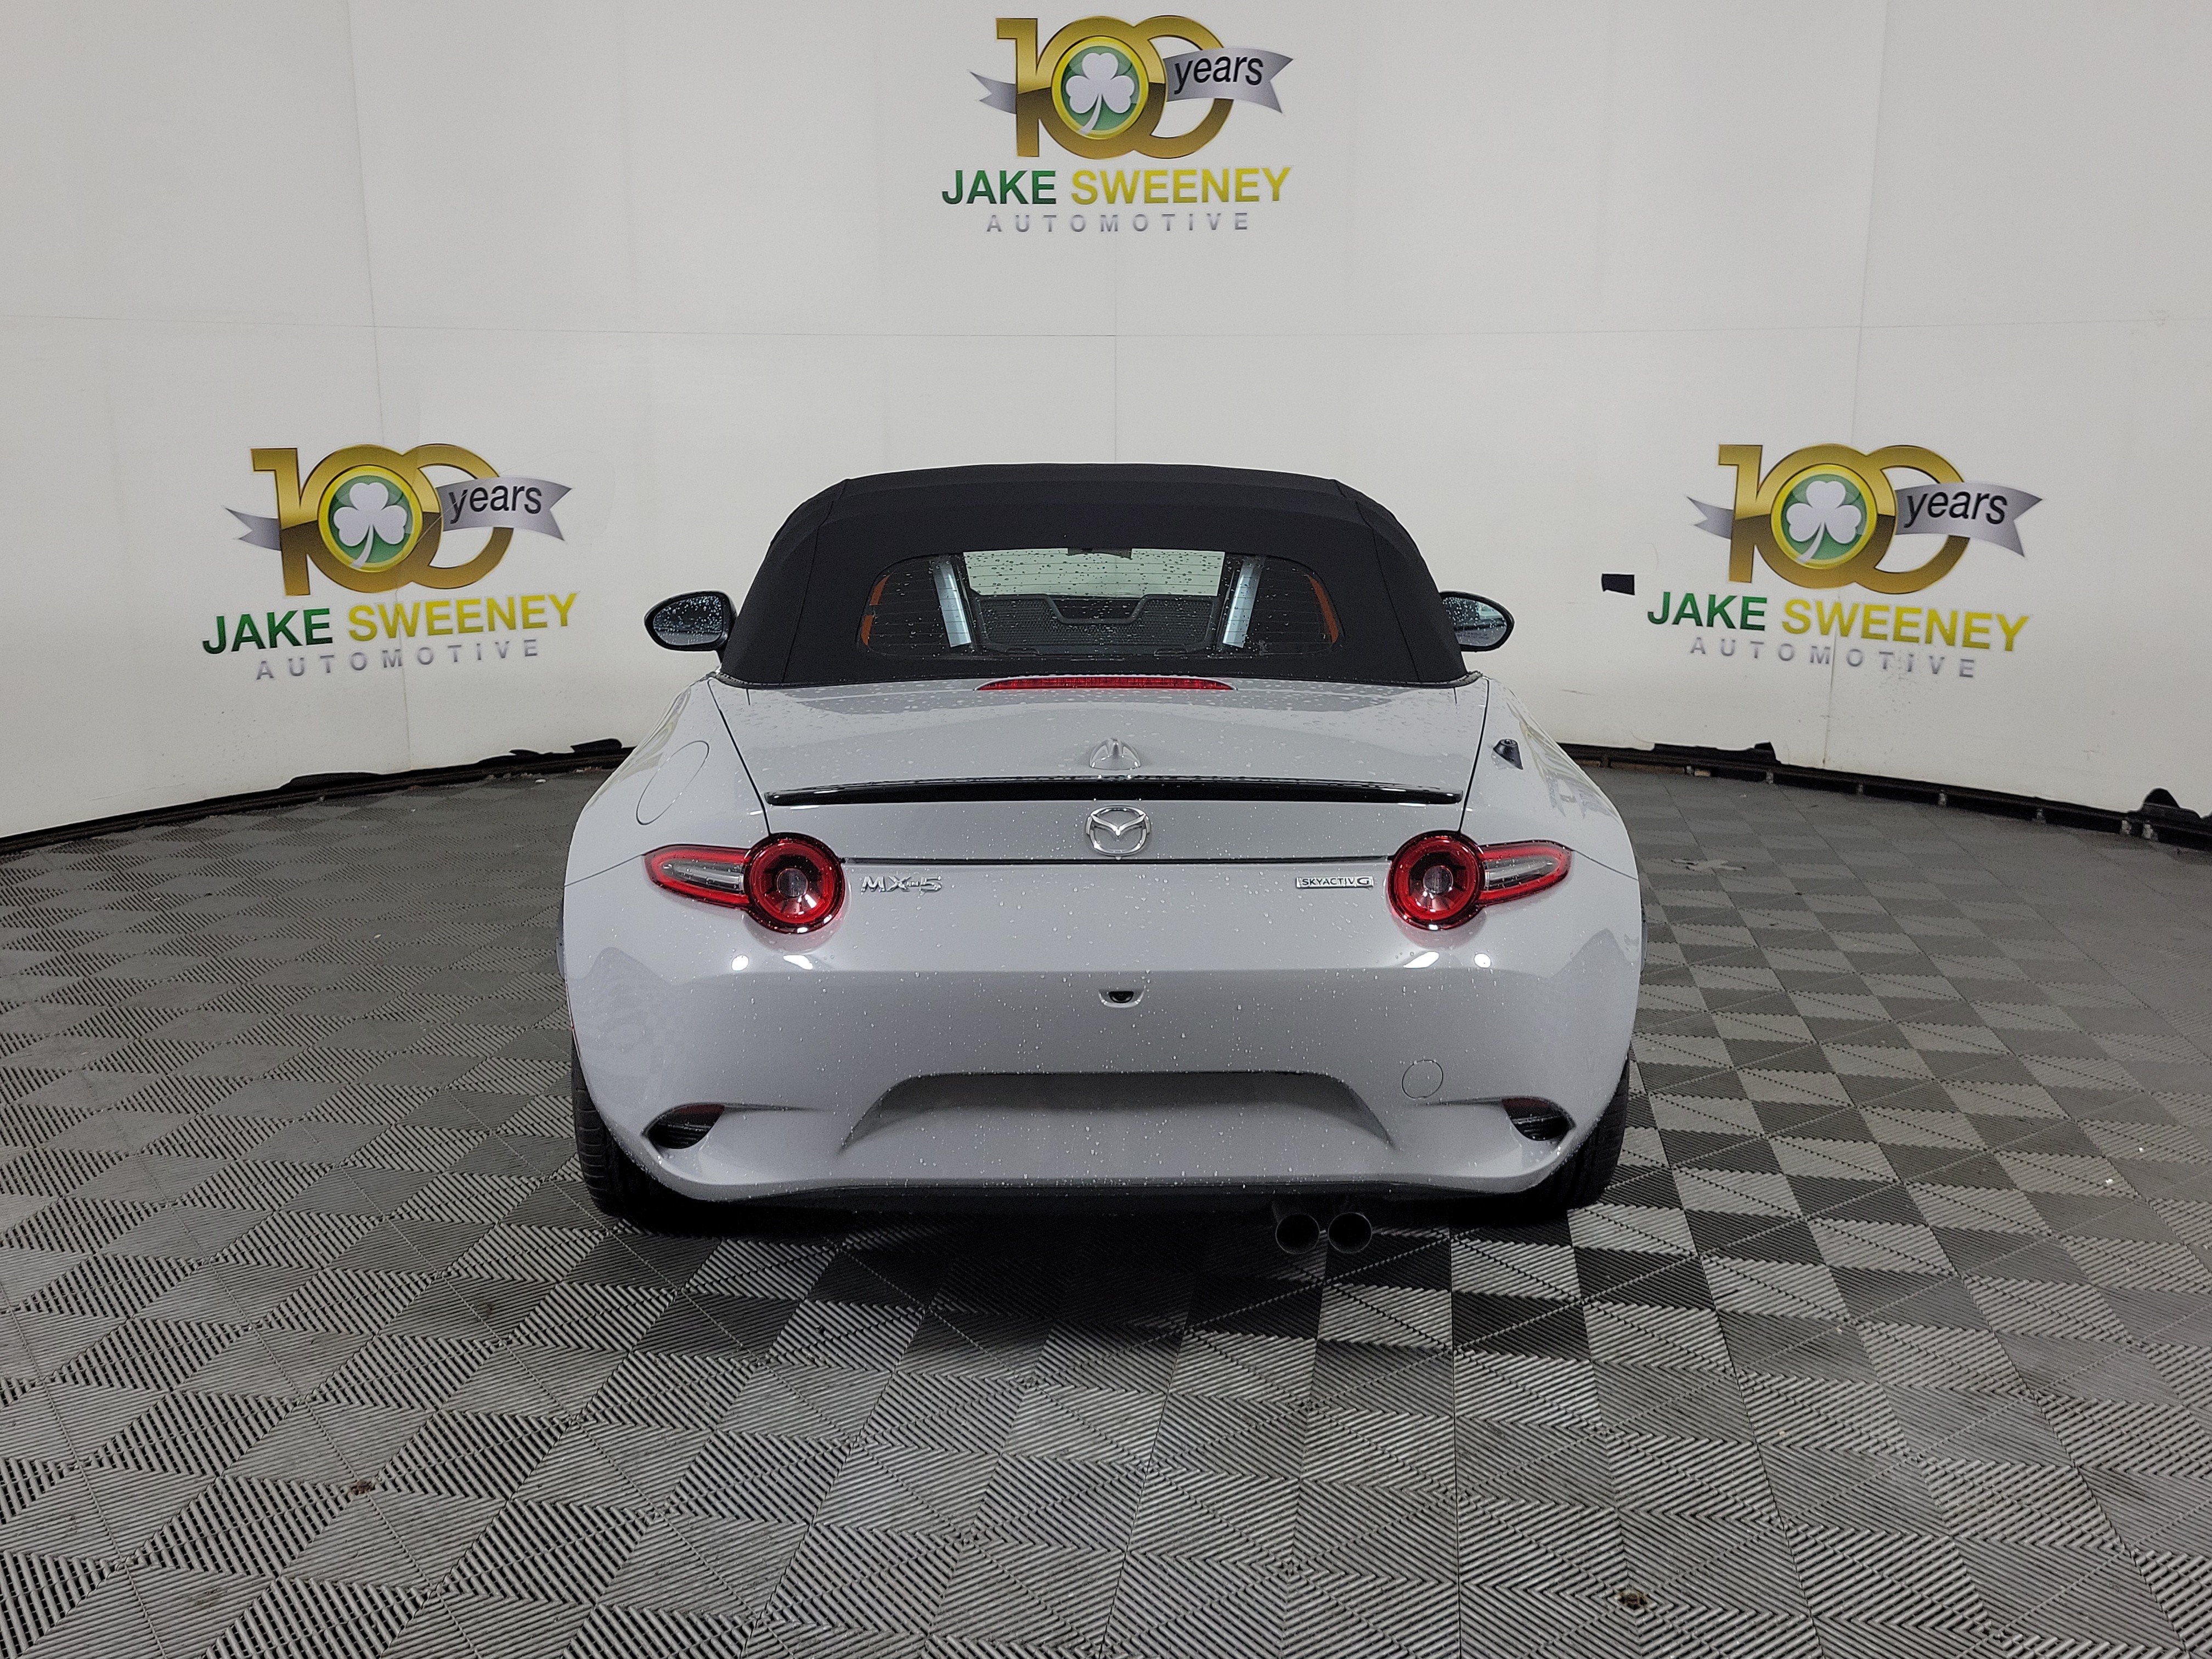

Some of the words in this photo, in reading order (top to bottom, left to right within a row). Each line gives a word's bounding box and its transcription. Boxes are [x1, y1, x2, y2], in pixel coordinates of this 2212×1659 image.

[996, 15, 1234, 160] 100
[1173, 56, 1263, 95] years
[941, 169, 1057, 205] JAKE
[1071, 167, 1291, 205] SWEENEY
[986, 212, 1249, 233] AUTOMOTIVE
[250, 443, 514, 596] 100
[448, 485, 543, 524] years
[1718, 443, 1971, 595] 100
[1903, 492, 2008, 528] years
[202, 607, 334, 655] JAKE
[348, 592, 578, 642] SWEENEY
[1647, 591, 1768, 631] JAKE
[1782, 599, 2029, 652] SWEENEY
[256, 639, 539, 681] AUTOMOTIVE
[1689, 636, 1976, 679] AUTOMOTIVE
[861, 875, 942, 893] MX-5
